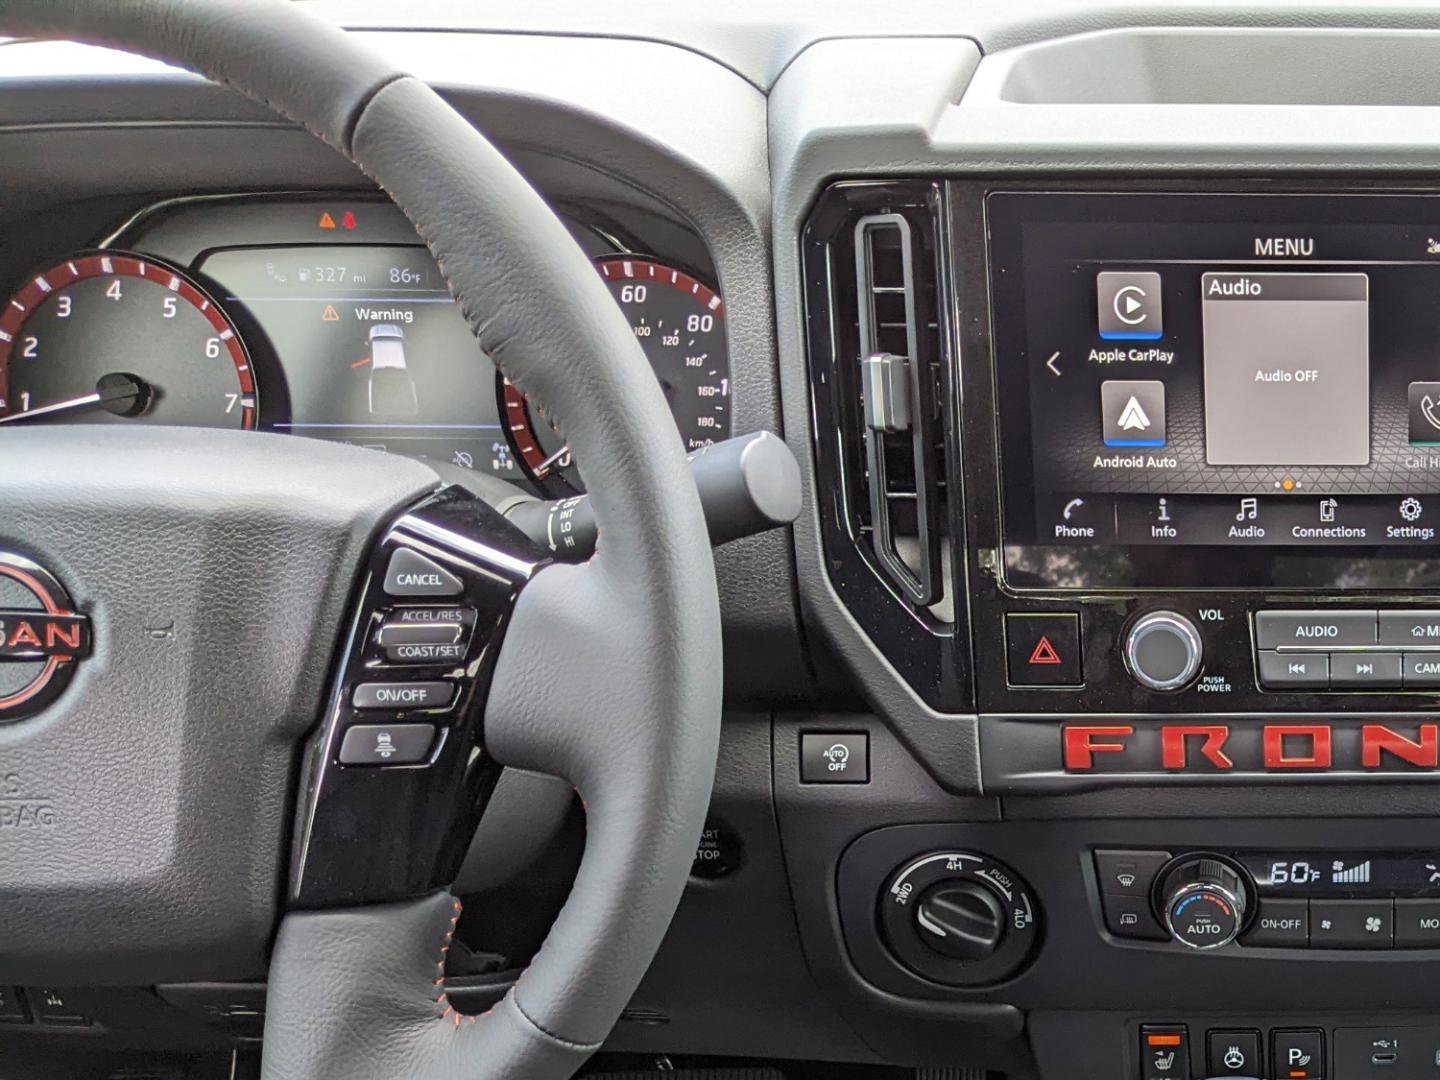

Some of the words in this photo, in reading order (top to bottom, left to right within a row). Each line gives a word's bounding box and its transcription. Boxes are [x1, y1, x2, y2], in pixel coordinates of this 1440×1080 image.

[1255, 238, 1314, 256] MENU
[315, 268, 346, 283] 327
[353, 274, 366, 283] mi
[106, 280, 122, 301] 4
[1208, 278, 1262, 296] Audio
[621, 285, 647, 303] 60
[57, 296, 72, 318] 3
[163, 298, 177, 318] 5
[356, 308, 413, 323] Warning
[687, 314, 714, 333] 80
[634, 326, 651, 337] 100
[662, 336, 680, 346] 120
[24, 338, 38, 358] 2
[206, 338, 220, 359] 6
[686, 356, 703, 367] 140
[1088, 349, 1126, 363] Apple
[1128, 349, 1174, 365] CarPlay
[1255, 370, 1292, 382] Audio
[1295, 370, 1319, 382] OFF
[698, 386, 715, 397] 160
[20, 392, 30, 412] 1
[225, 394, 238, 414] 7
[698, 416, 714, 427] 180
[689, 438, 714, 448] km/h
[1093, 456, 1144, 469] Android
[1146, 456, 1177, 469] Auto
[1406, 457, 1427, 470] Call
[560, 508, 575, 520] INT
[560, 522, 572, 533] LO
[1055, 525, 1095, 538] Phone
[1151, 525, 1177, 538] Info
[1228, 525, 1266, 538] Audio
[1292, 525, 1367, 538] Connections
[1386, 525, 1435, 540] Settings
[564, 536, 576, 548] HI
[396, 574, 443, 586] CANCEL
[402, 610, 463, 622] ACCEL/RES
[1198, 609, 1225, 621] VOL
[0, 620, 81, 649] AN
[1295, 625, 1339, 638] AUDIO
[398, 646, 461, 658] COAST/SET
[1203, 676, 1225, 684] PUSH
[1198, 684, 1232, 692] POWER
[376, 690, 428, 701] ON/OFF
[828, 762, 847, 772] OFF
[698, 850, 721, 860] TOP
[946, 861, 962, 871] 4H
[989, 868, 1012, 890] PUSH
[895, 882, 913, 905] 2WD
[1014, 908, 1025, 929] 4LO
[1187, 924, 1221, 934] AUTO
[1393, 1040, 1398, 1048] 1
